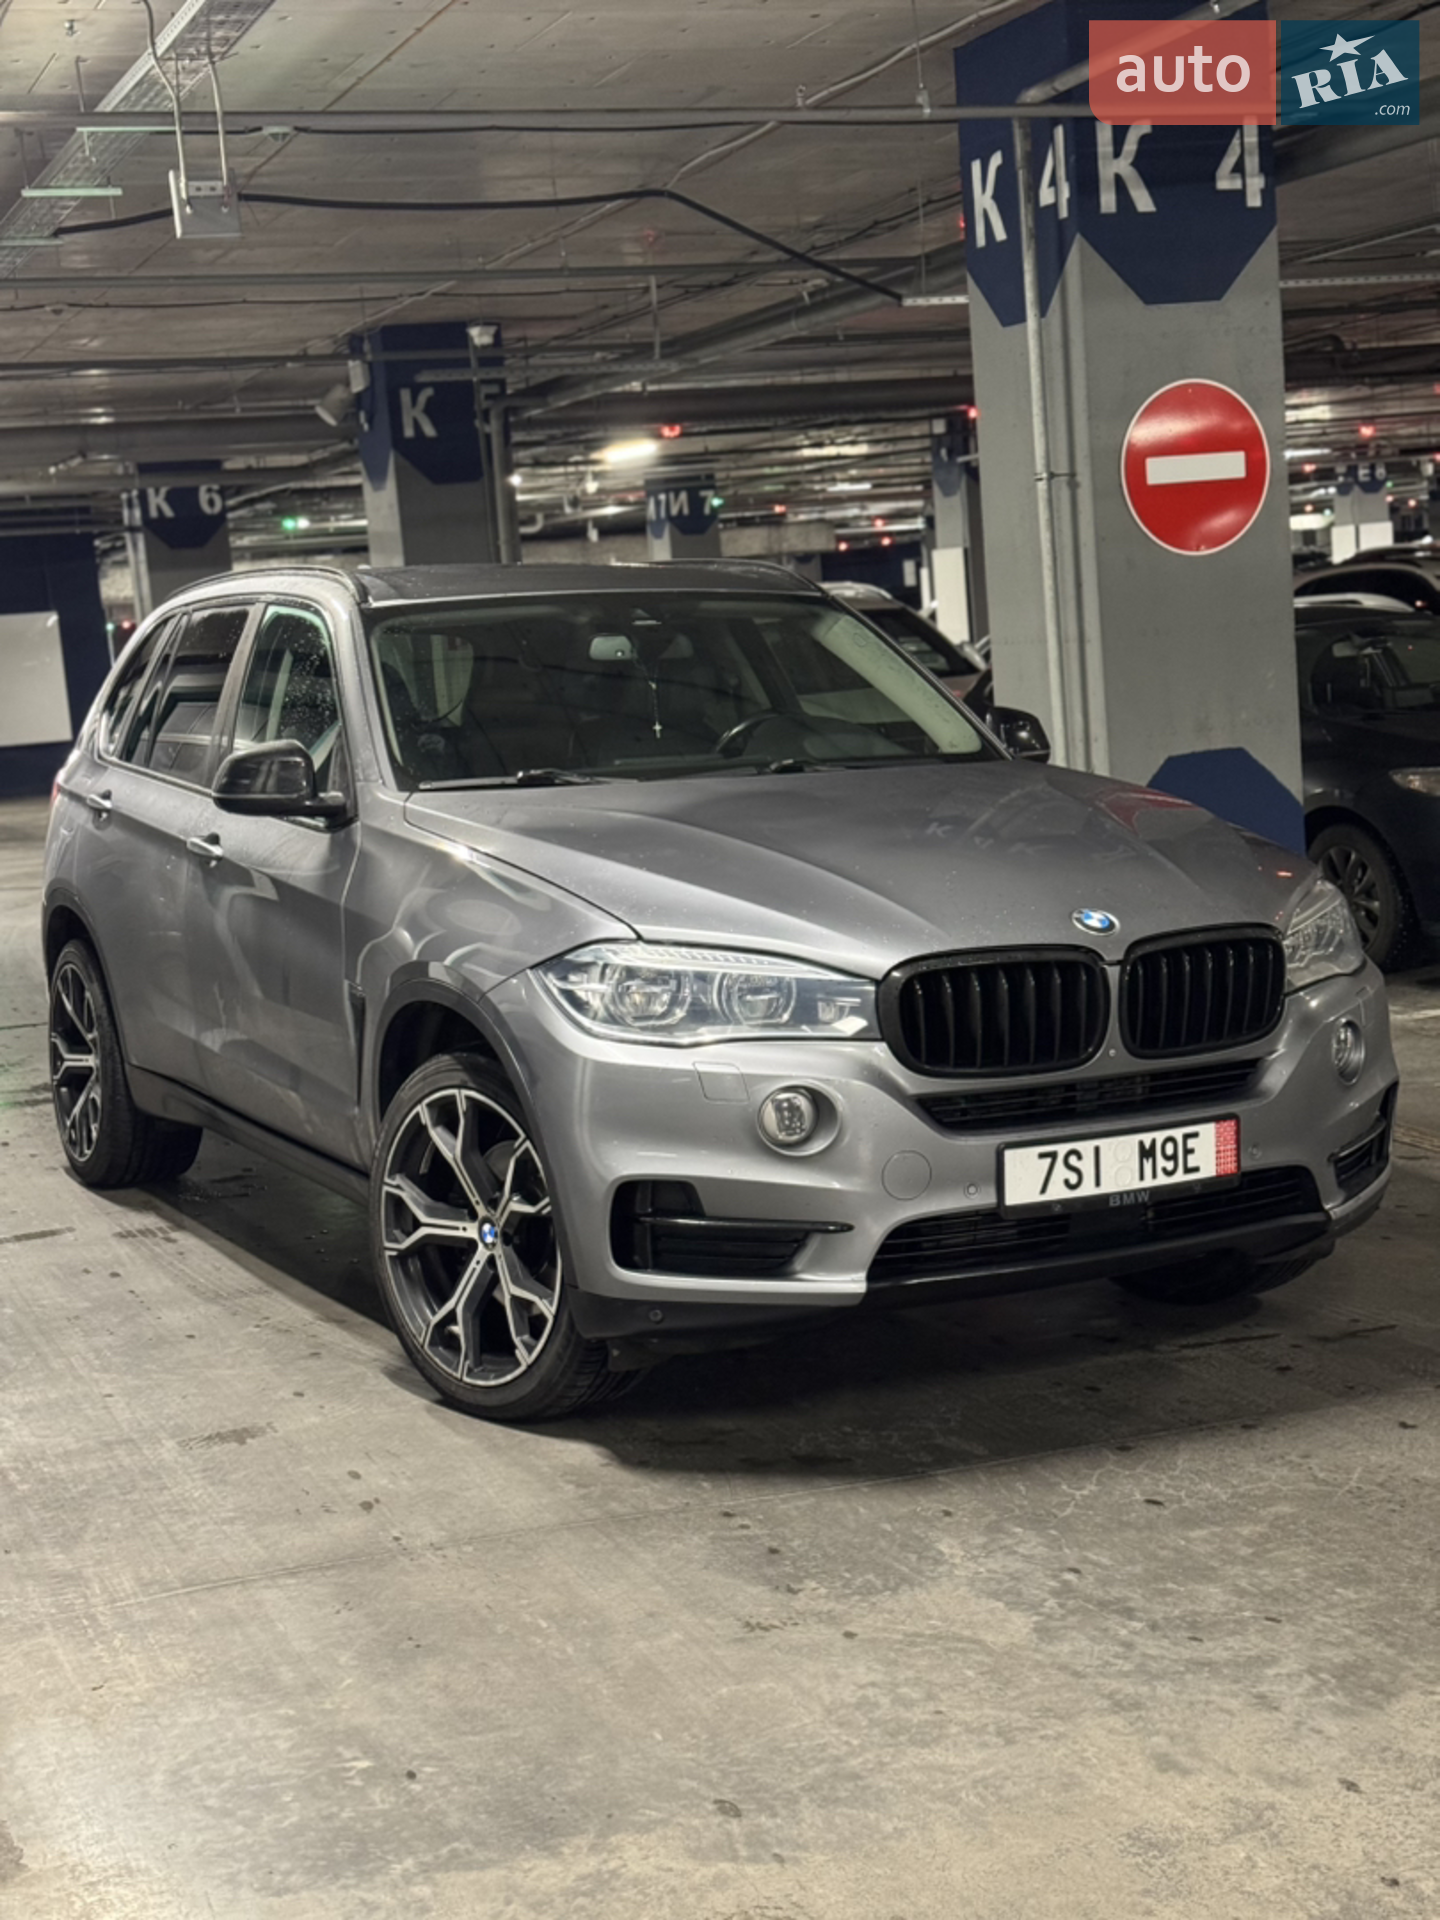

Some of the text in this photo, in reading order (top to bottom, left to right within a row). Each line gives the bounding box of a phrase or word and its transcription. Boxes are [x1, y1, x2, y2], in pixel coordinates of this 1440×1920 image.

[1039, 124, 1070, 219] 4
[1215, 115, 1266, 208] 4
[198, 484, 223, 516] 6
[699, 489, 714, 515] 7
[1138, 1131, 1201, 1182] M9E
[1109, 1190, 1150, 1207] BMW
